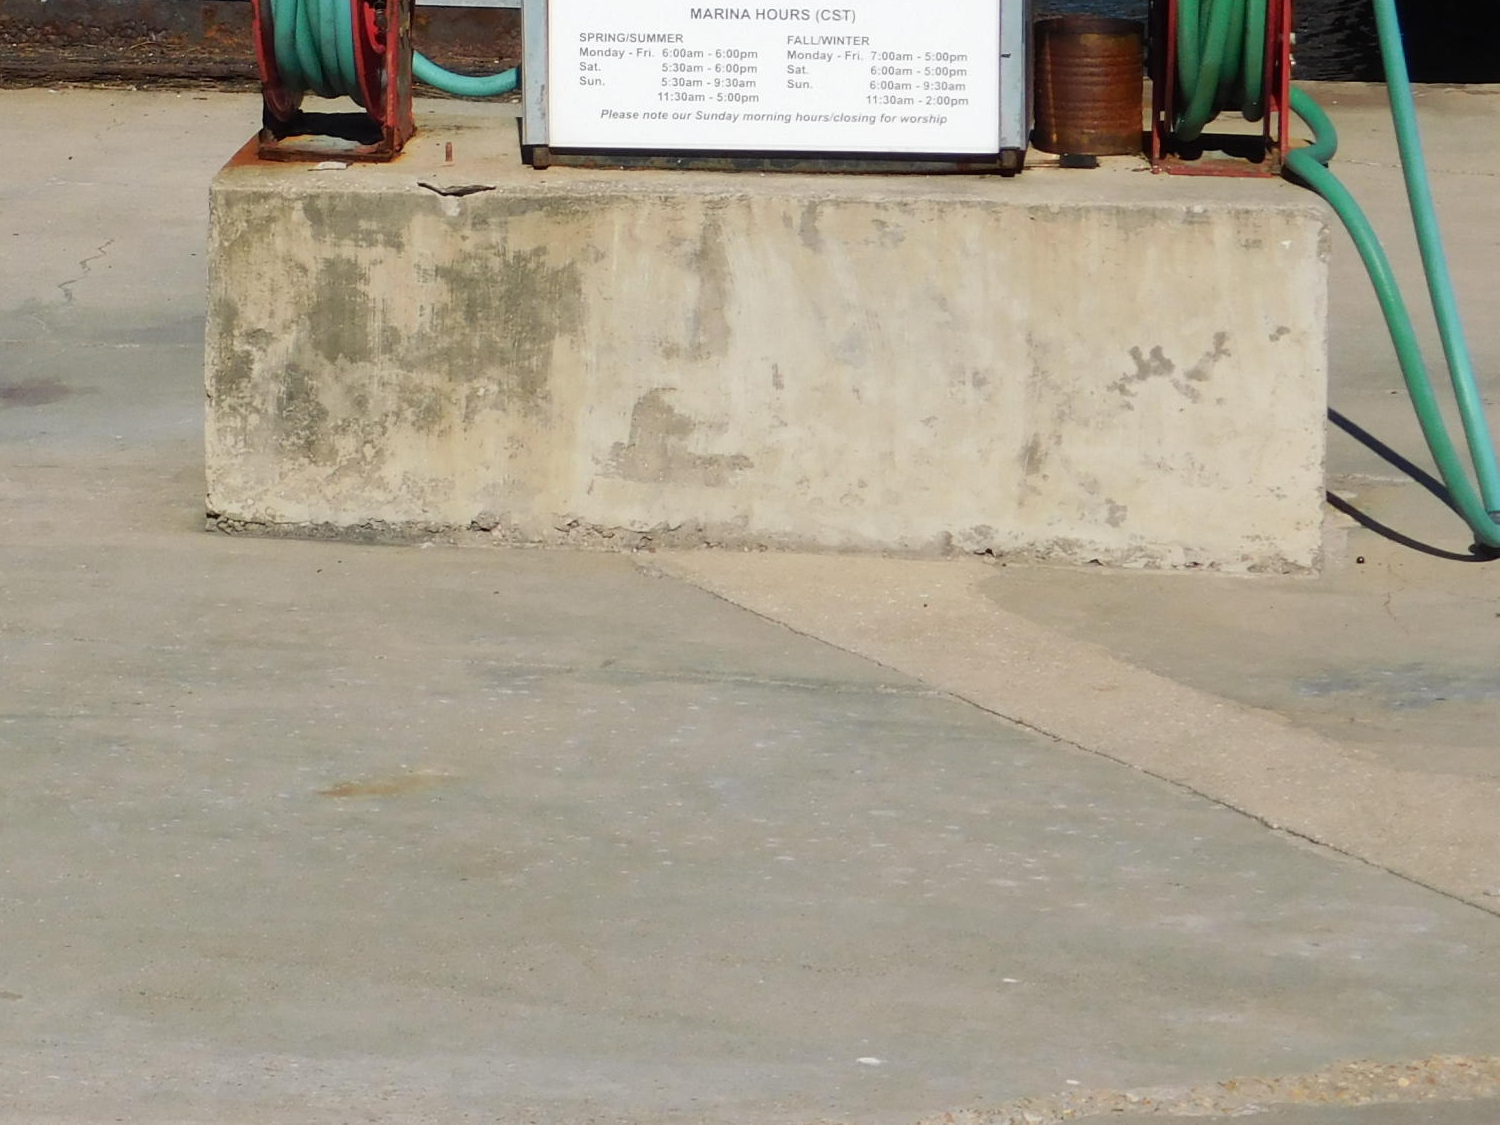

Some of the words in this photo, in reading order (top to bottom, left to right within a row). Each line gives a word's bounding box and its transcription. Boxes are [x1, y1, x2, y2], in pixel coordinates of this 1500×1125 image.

[691, 8, 751, 19] MARINA
[756, 9, 810, 20] HOURS
[816, 9, 855, 23] (CST)
[580, 33, 683, 43] SPRING/SUMMER
[788, 36, 869, 45] FALL/WINTER
[580, 47, 625, 59] Monday
[637, 48, 655, 57] Fri.
[662, 48, 703, 58] 6:00am
[716, 49, 757, 61] 6:00pm
[788, 50, 833, 62] Monday
[845, 51, 863, 60] Fri.
[871, 51, 913, 61] 7:00am
[925, 52, 967, 63] 5:00pm
[580, 62, 601, 71] Sat.
[662, 63, 703, 72] 5:30am
[715, 63, 757, 75] 6:00pm
[787, 65, 808, 74] Sat.
[871, 66, 912, 75] 6:00am
[925, 67, 967, 78] 5:00pm
[580, 76, 605, 86] Sun.
[661, 77, 702, 87] 5:30am
[714, 78, 756, 87] 9:30am
[787, 79, 812, 88] Sun.
[870, 81, 911, 90] 6:00am
[923, 81, 965, 91] 9:30am
[658, 92, 705, 101] 11:30am
[717, 93, 759, 104] 5:00pm
[866, 95, 914, 105] 11:30am
[926, 96, 968, 107] 2:00pm
[601, 109, 639, 119] Please
[695, 111, 739, 123] Sunday
[743, 114, 791, 125] morning
[796, 113, 876, 125] hours/closing
[880, 113, 897, 123] for
[900, 115, 947, 125] worship
